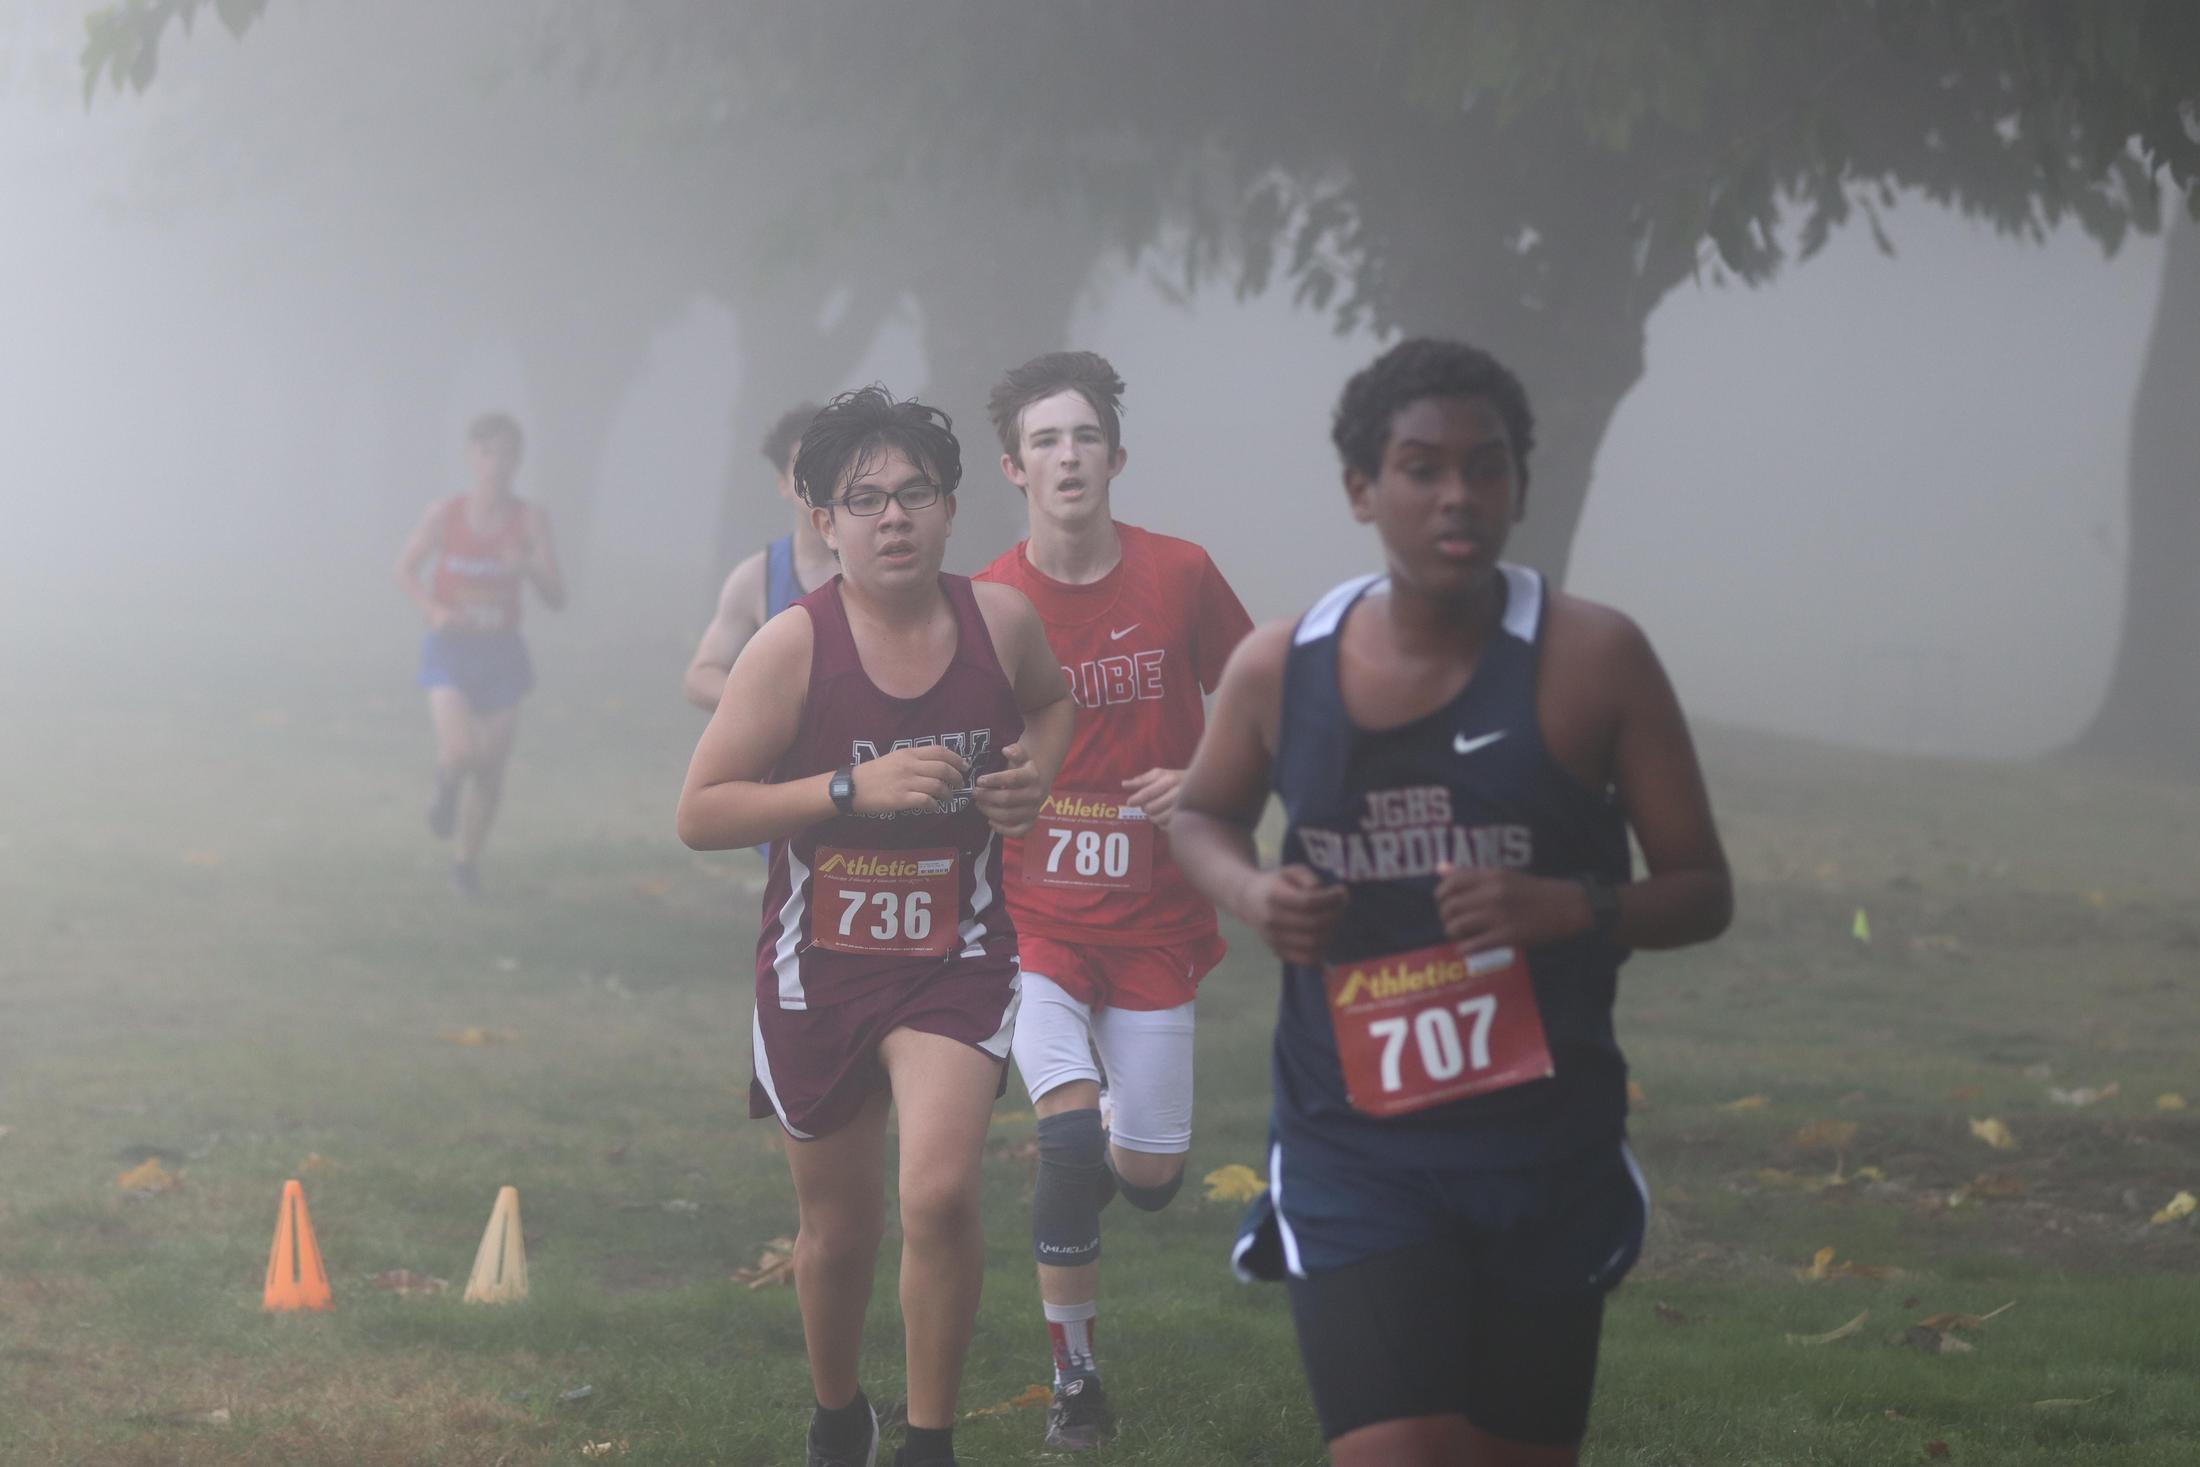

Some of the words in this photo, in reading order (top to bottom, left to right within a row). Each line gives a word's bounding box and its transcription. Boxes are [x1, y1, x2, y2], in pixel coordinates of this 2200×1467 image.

[1061, 649, 1165, 707] RIBE
[1040, 795, 1117, 818] Athletic
[1359, 785, 1453, 830] JGHS
[819, 853, 918, 876] Athletic
[1046, 828, 1130, 878] 780
[838, 889, 932, 940] 736
[1336, 960, 1466, 1006] Athletic
[1368, 994, 1498, 1093] 707
